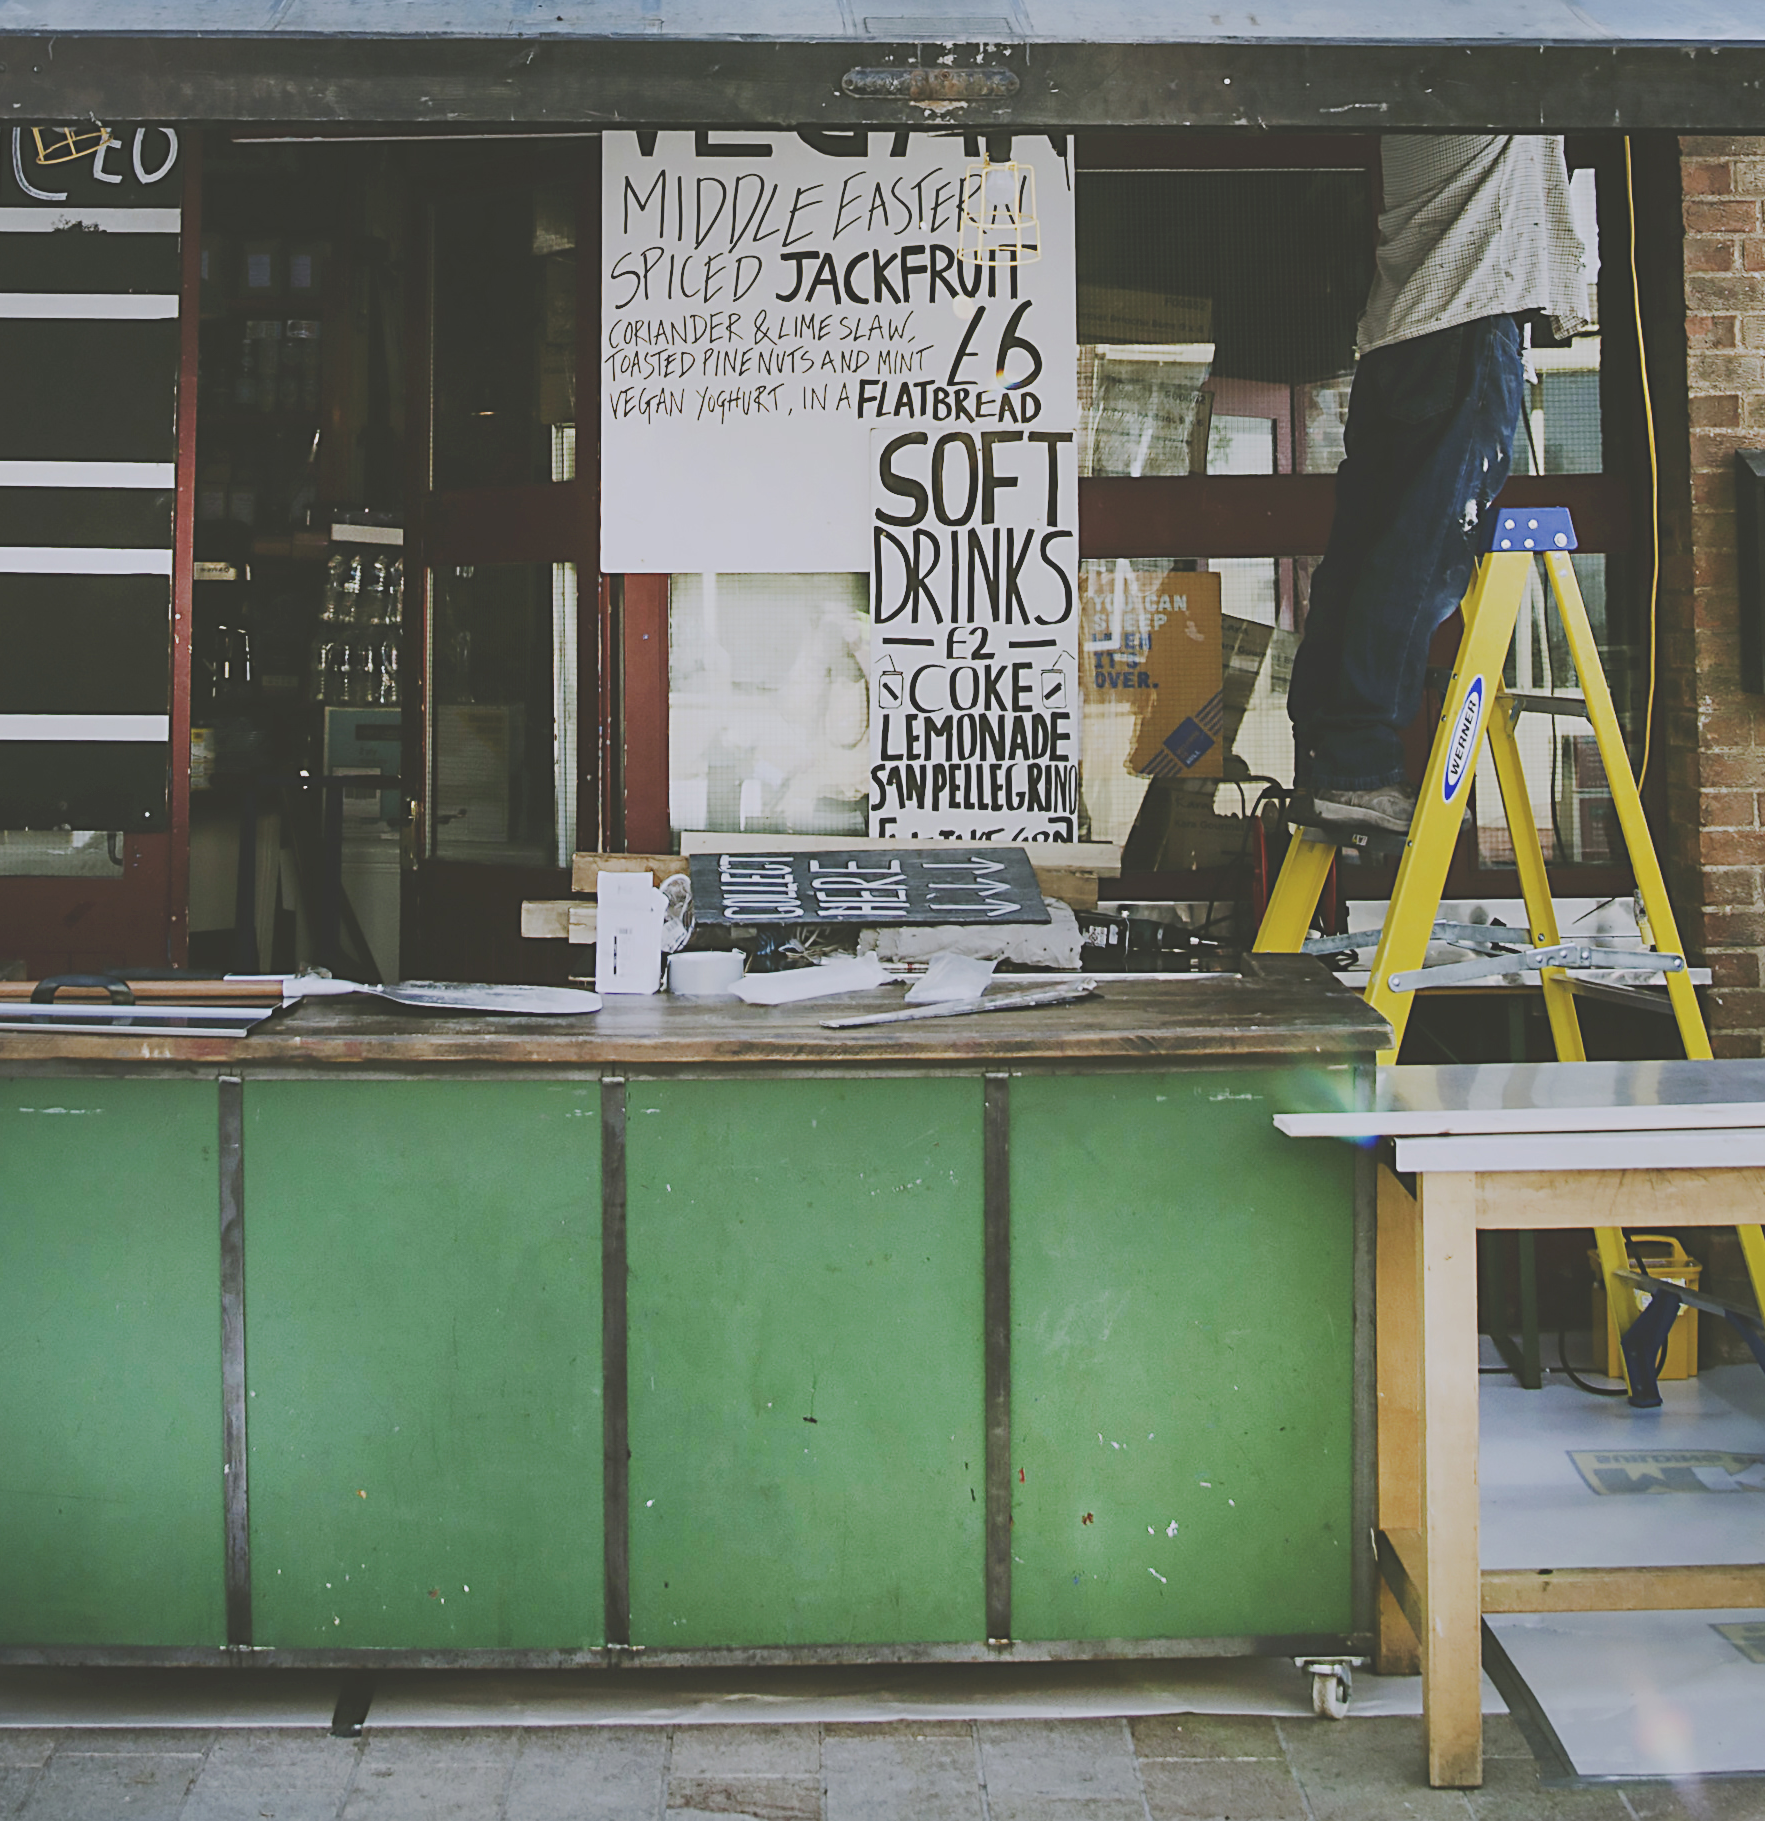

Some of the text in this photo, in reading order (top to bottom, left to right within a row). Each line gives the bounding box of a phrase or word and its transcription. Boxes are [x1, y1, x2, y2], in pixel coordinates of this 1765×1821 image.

[622, 168, 825, 255] MIDDLE
[610, 243, 1038, 310] SPICED JACKFRUIT
[609, 310, 916, 349] CORIANDER & LIME SLAW,
[604, 348, 695, 382] TOASTED
[820, 349, 870, 375] AND
[877, 345, 934, 375] MINT
[609, 379, 1043, 425] VEGAN YOGHURT, IN A FLATBREAD
[874, 431, 1073, 527] SOFT
[874, 526, 1073, 626] DRINKS
[1145, 594, 1187, 612] CAN
[909, 662, 1034, 714] COKE
[1095, 671, 1160, 690] OVER.
[880, 712, 1071, 762] LEMONADE
[1449, 698, 1477, 776] WERNER
[932, 763, 1078, 816] PELLEGRINO
[809, 859, 911, 917] HERE
